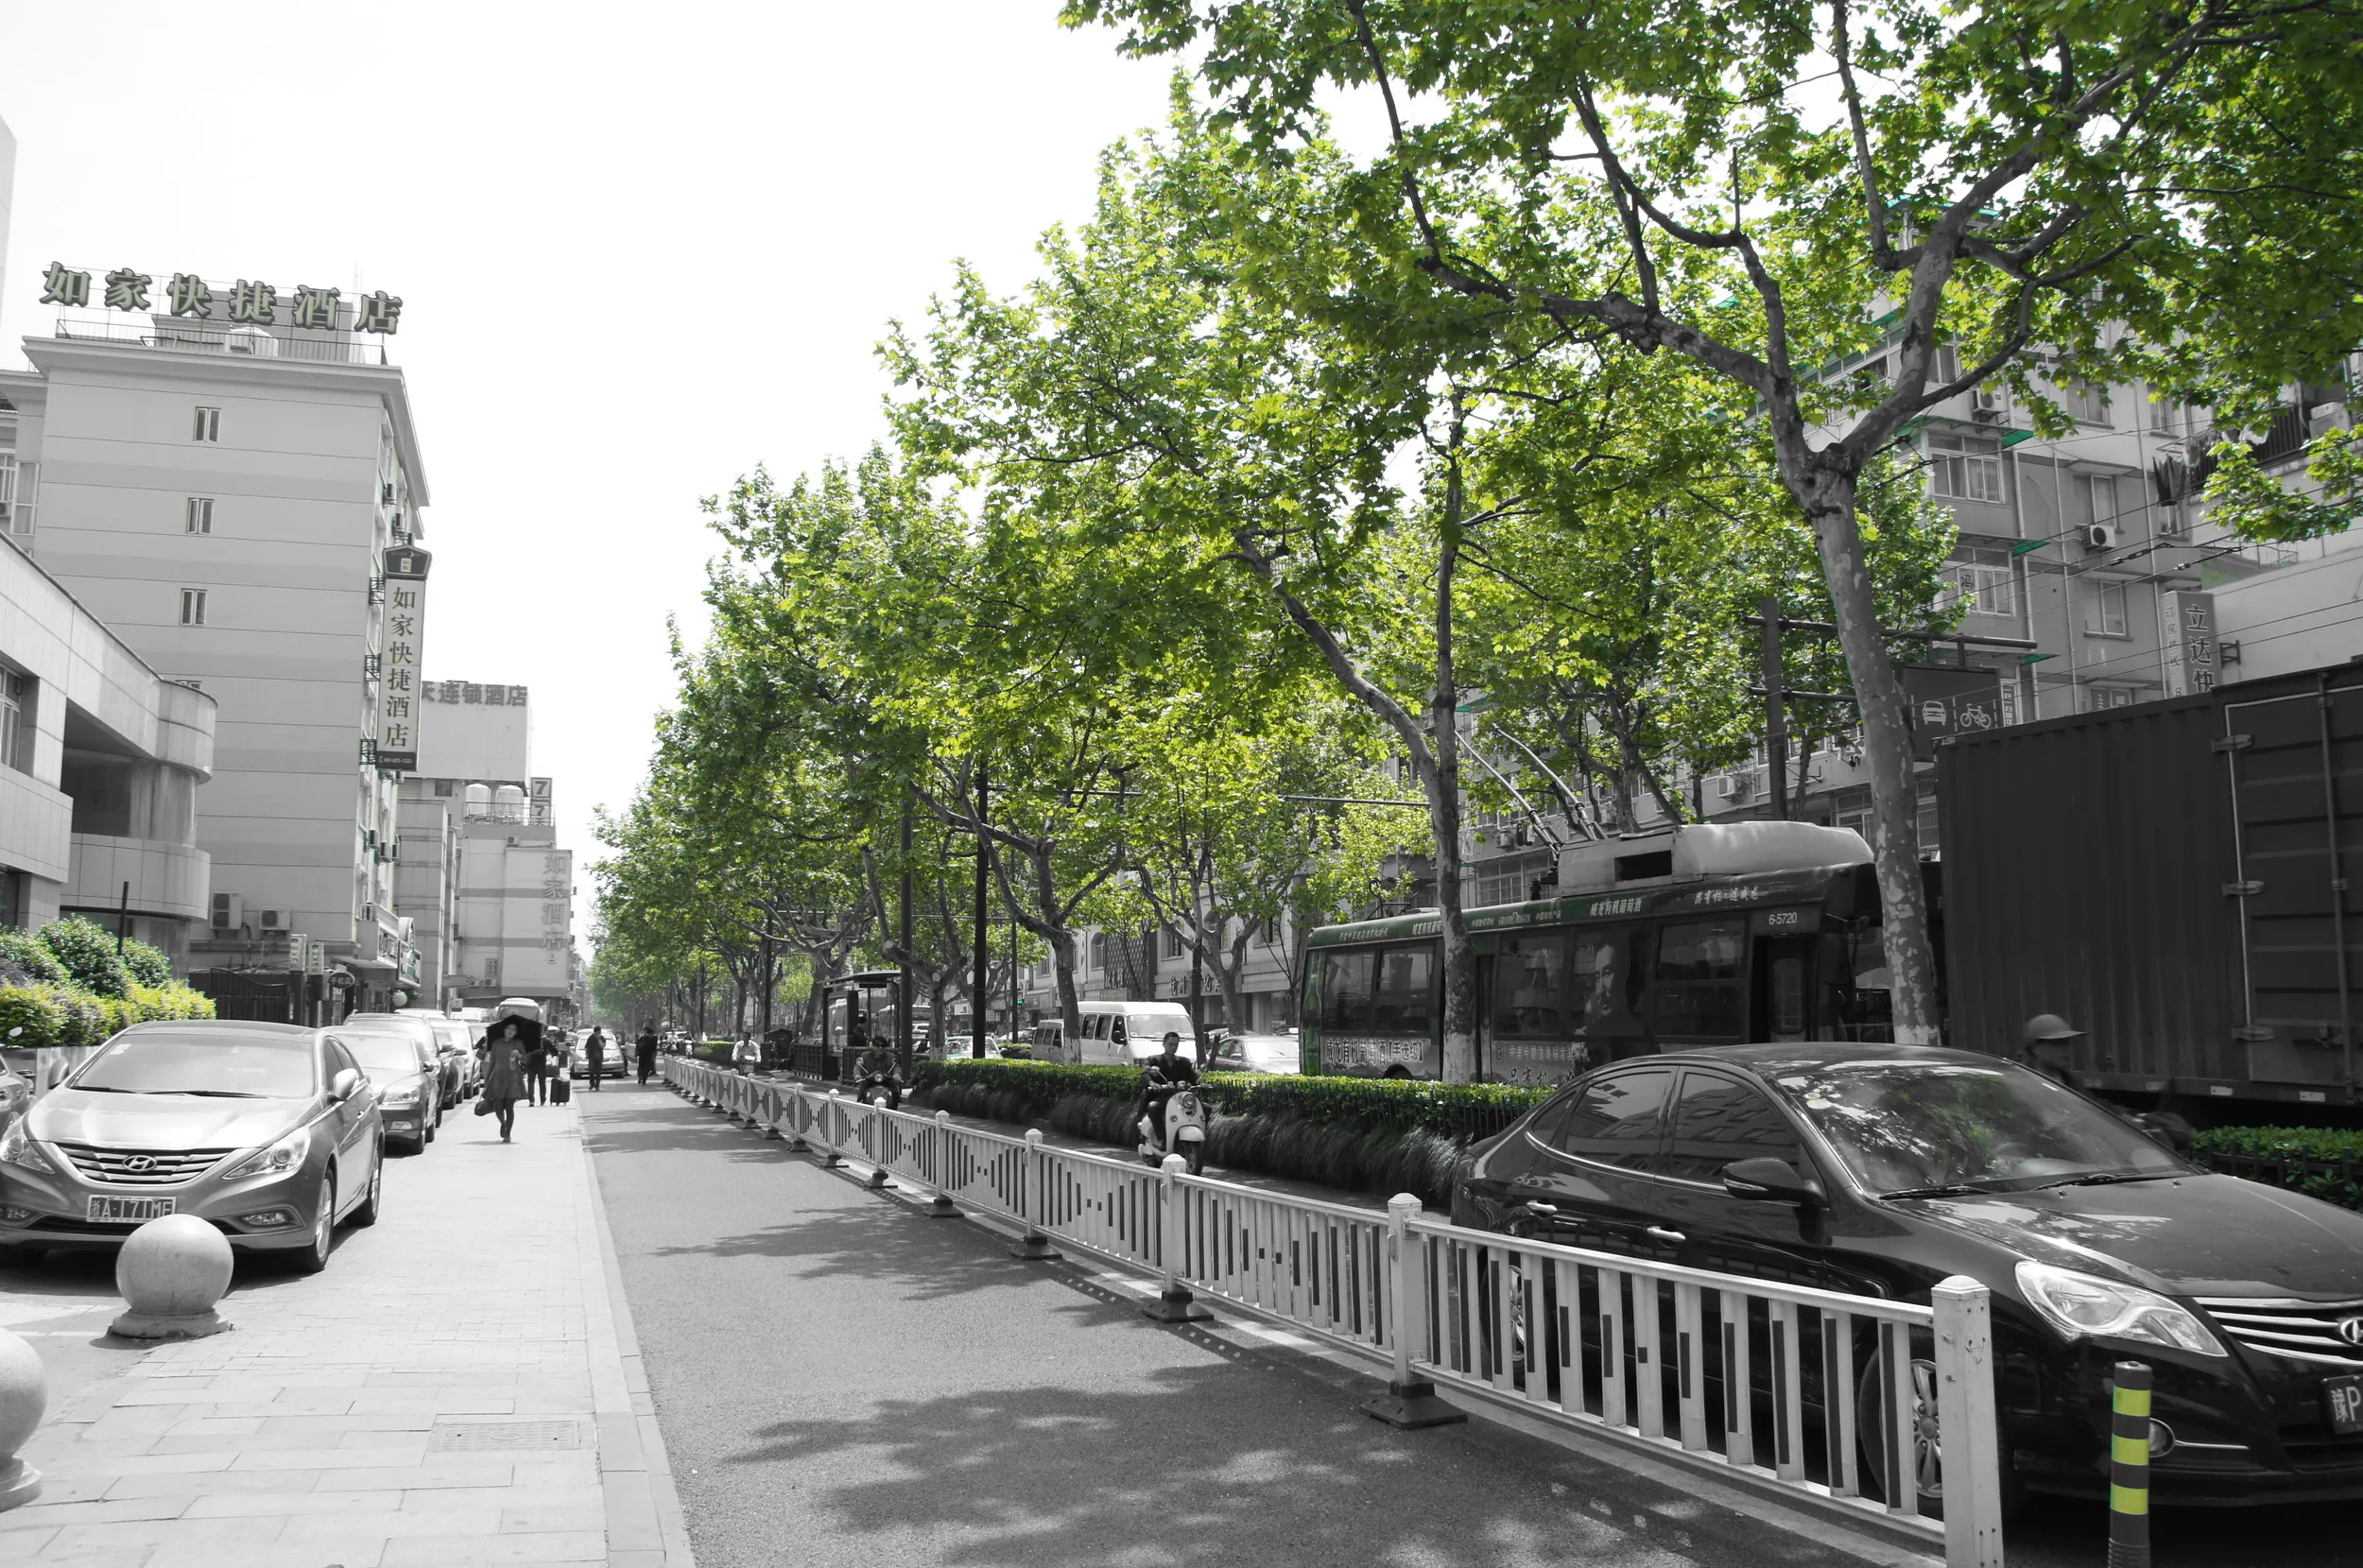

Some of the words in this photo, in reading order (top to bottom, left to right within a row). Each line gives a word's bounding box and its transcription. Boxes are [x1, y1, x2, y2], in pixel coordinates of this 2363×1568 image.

[40, 261, 403, 335] 如家快捷酒店
[385, 586, 417, 747] 如家快捷酒店
[2185, 604, 2216, 693] 立达快
[534, 781, 548, 796] 7
[542, 853, 567, 951] 如家酒店
[1590, 897, 1643, 917] 威龙有机葡萄酒
[1768, 911, 1798, 925] 6-5720
[1412, 920, 1444, 936] 威龙有机葡萄
